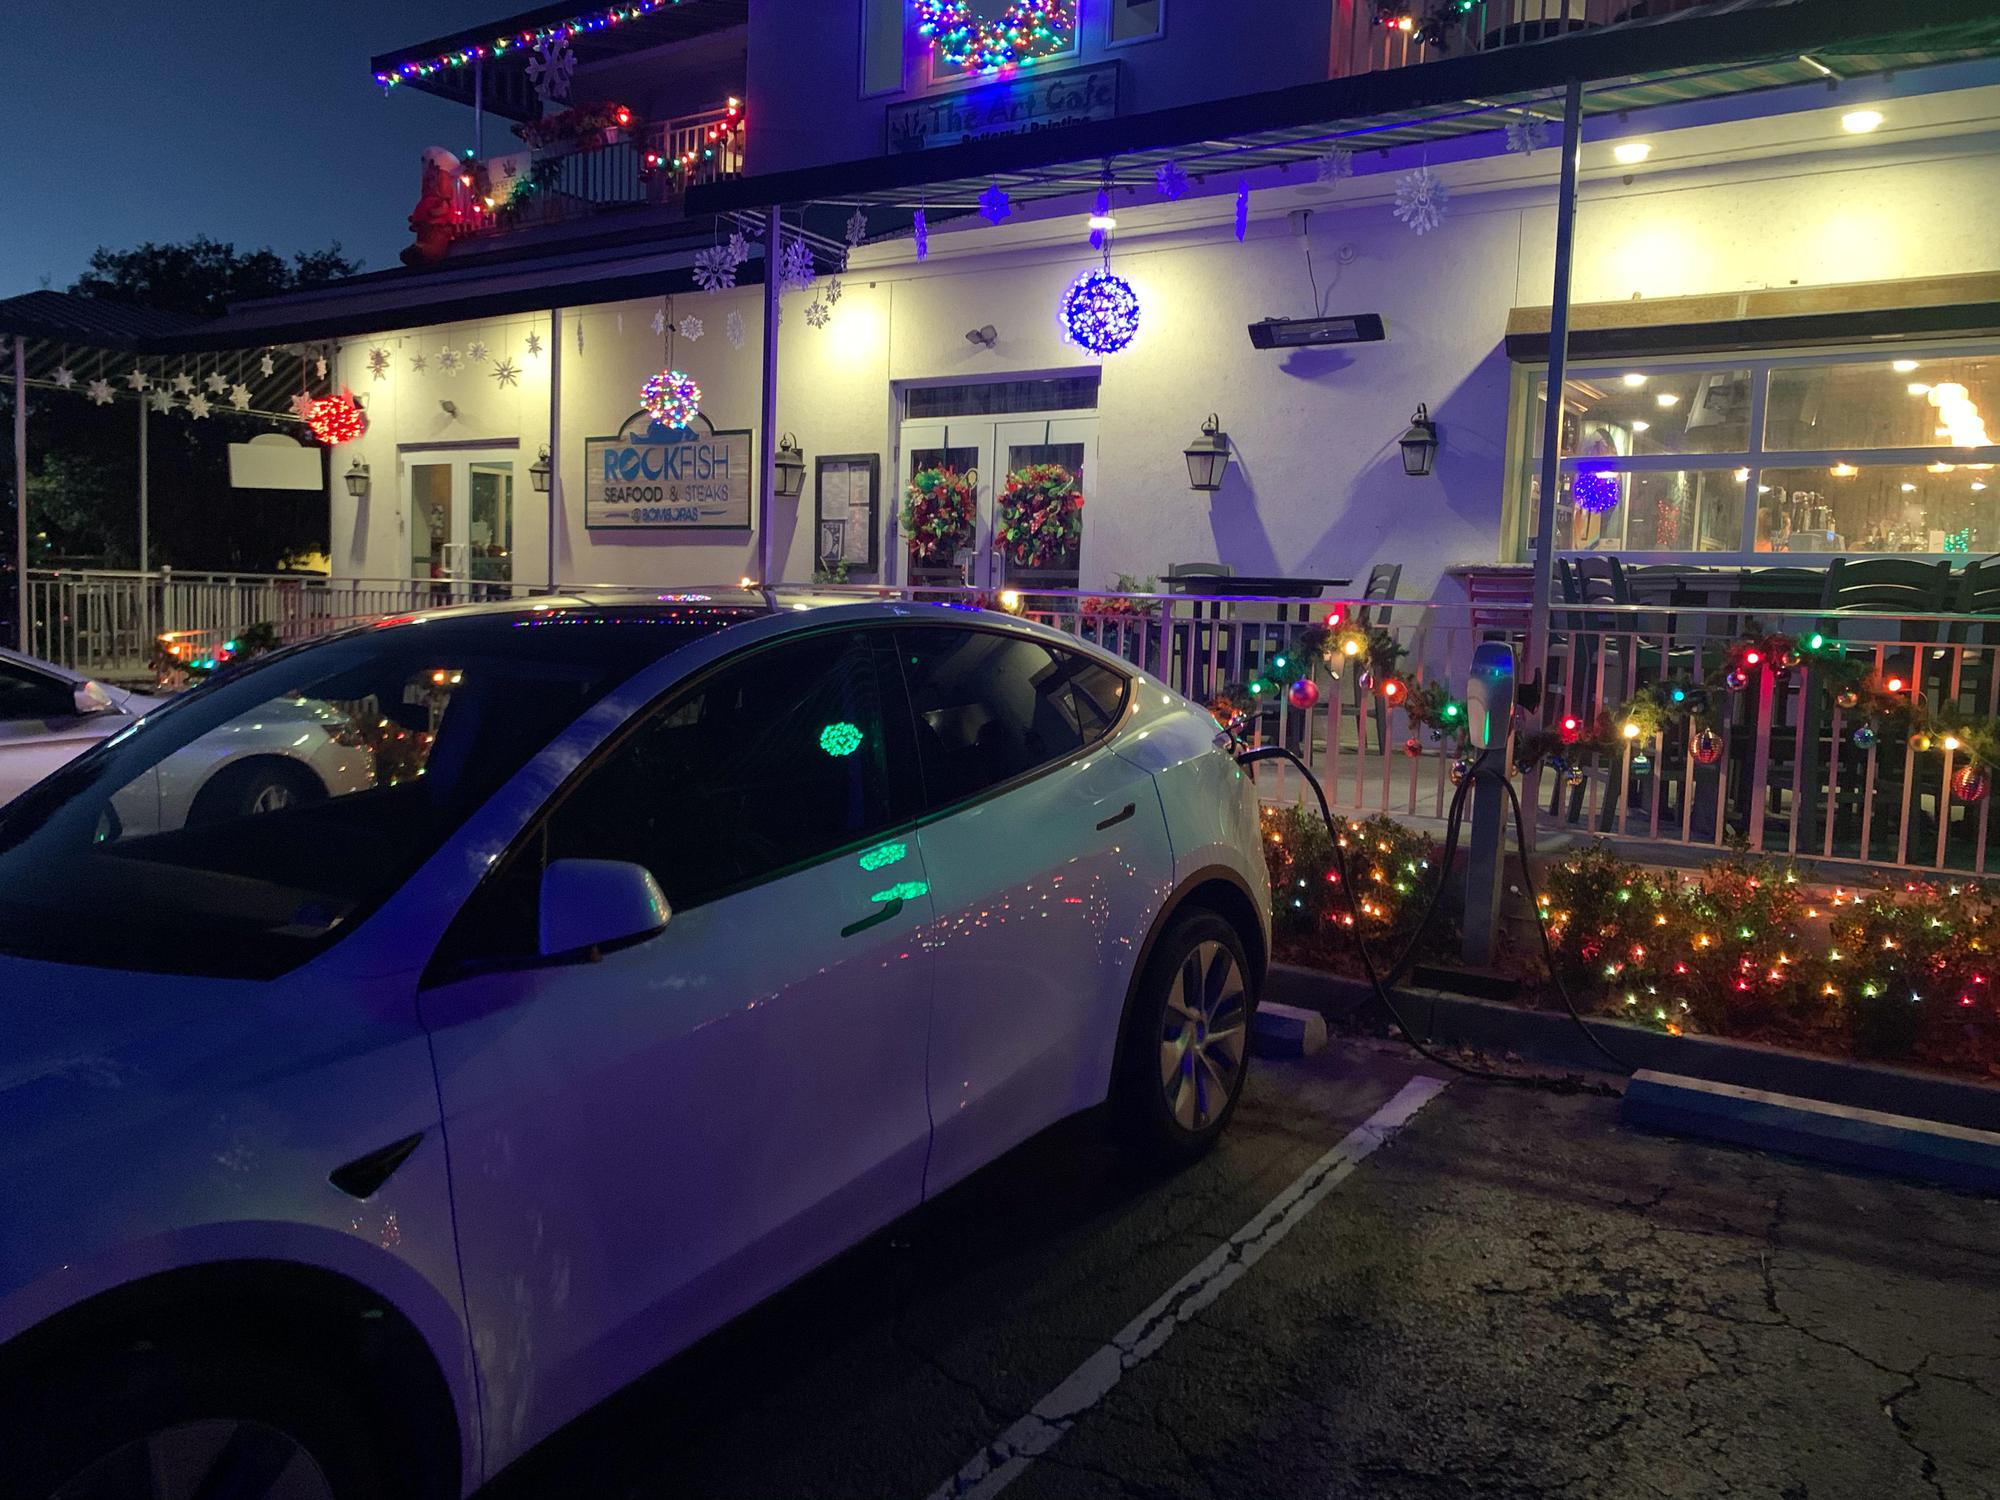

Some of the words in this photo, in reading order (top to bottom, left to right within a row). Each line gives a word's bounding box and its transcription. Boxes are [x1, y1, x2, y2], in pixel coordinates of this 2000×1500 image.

[928, 103, 980, 134] The
[986, 93, 1037, 124] Art
[1045, 74, 1112, 112] Cafe
[604, 445, 729, 481] ROCKFISH
[604, 486, 663, 503] SEAFOOD
[669, 486, 679, 503] &
[685, 484, 729, 501] STEAKS
